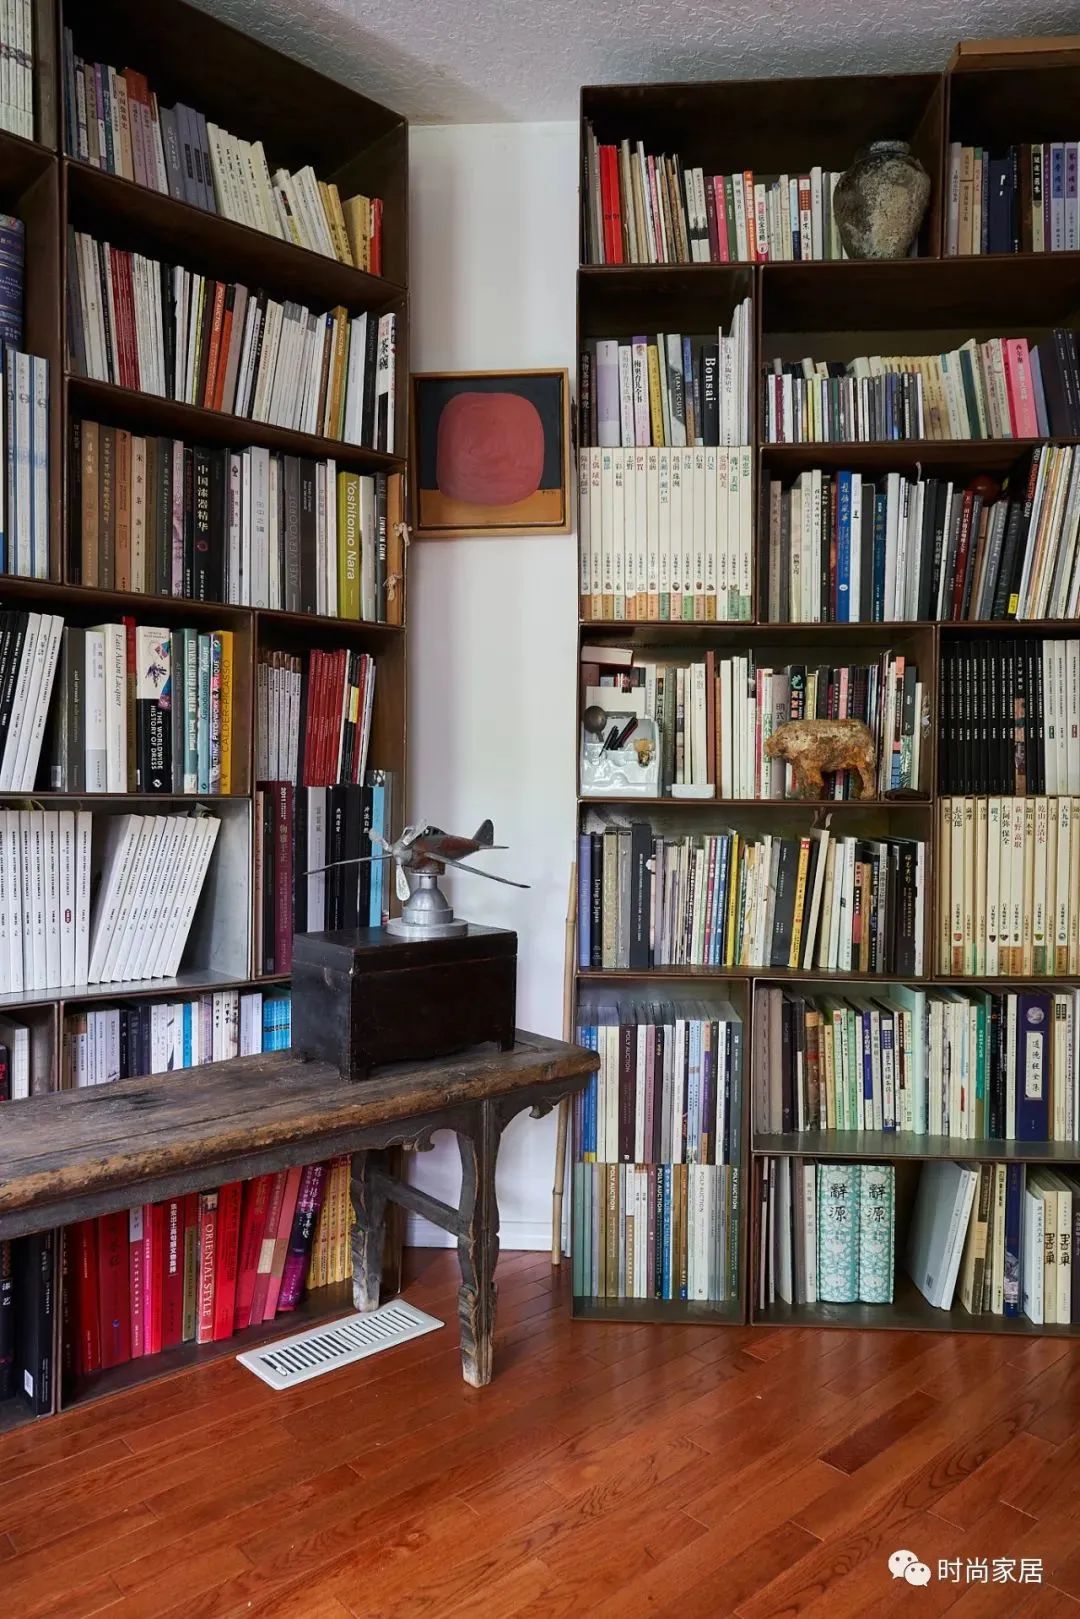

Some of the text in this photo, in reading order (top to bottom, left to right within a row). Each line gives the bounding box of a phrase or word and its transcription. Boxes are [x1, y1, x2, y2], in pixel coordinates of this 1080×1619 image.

[705, 357, 717, 402] Bonsai
[197, 464, 209, 533] 中国漆器精华
[346, 480, 358, 580] Yoshitomo Nara
[114, 633, 123, 707] East Asian Lacquer
[201, 672, 210, 721] contemporary
[221, 659, 231, 753] CALDER-PICASSO
[776, 703, 786, 723] 明式
[150, 736, 157, 746] OF
[953, 805, 963, 828] 長次郎
[1002, 829, 1011, 845] 保全
[592, 878, 601, 923] Living in Japan
[828, 1183, 849, 1223] 辭源
[867, 1183, 886, 1223] 辭源
[203, 1224, 214, 1317] ORIENTAL STYLE
[2, 1282, 11, 1306] 漆艺
